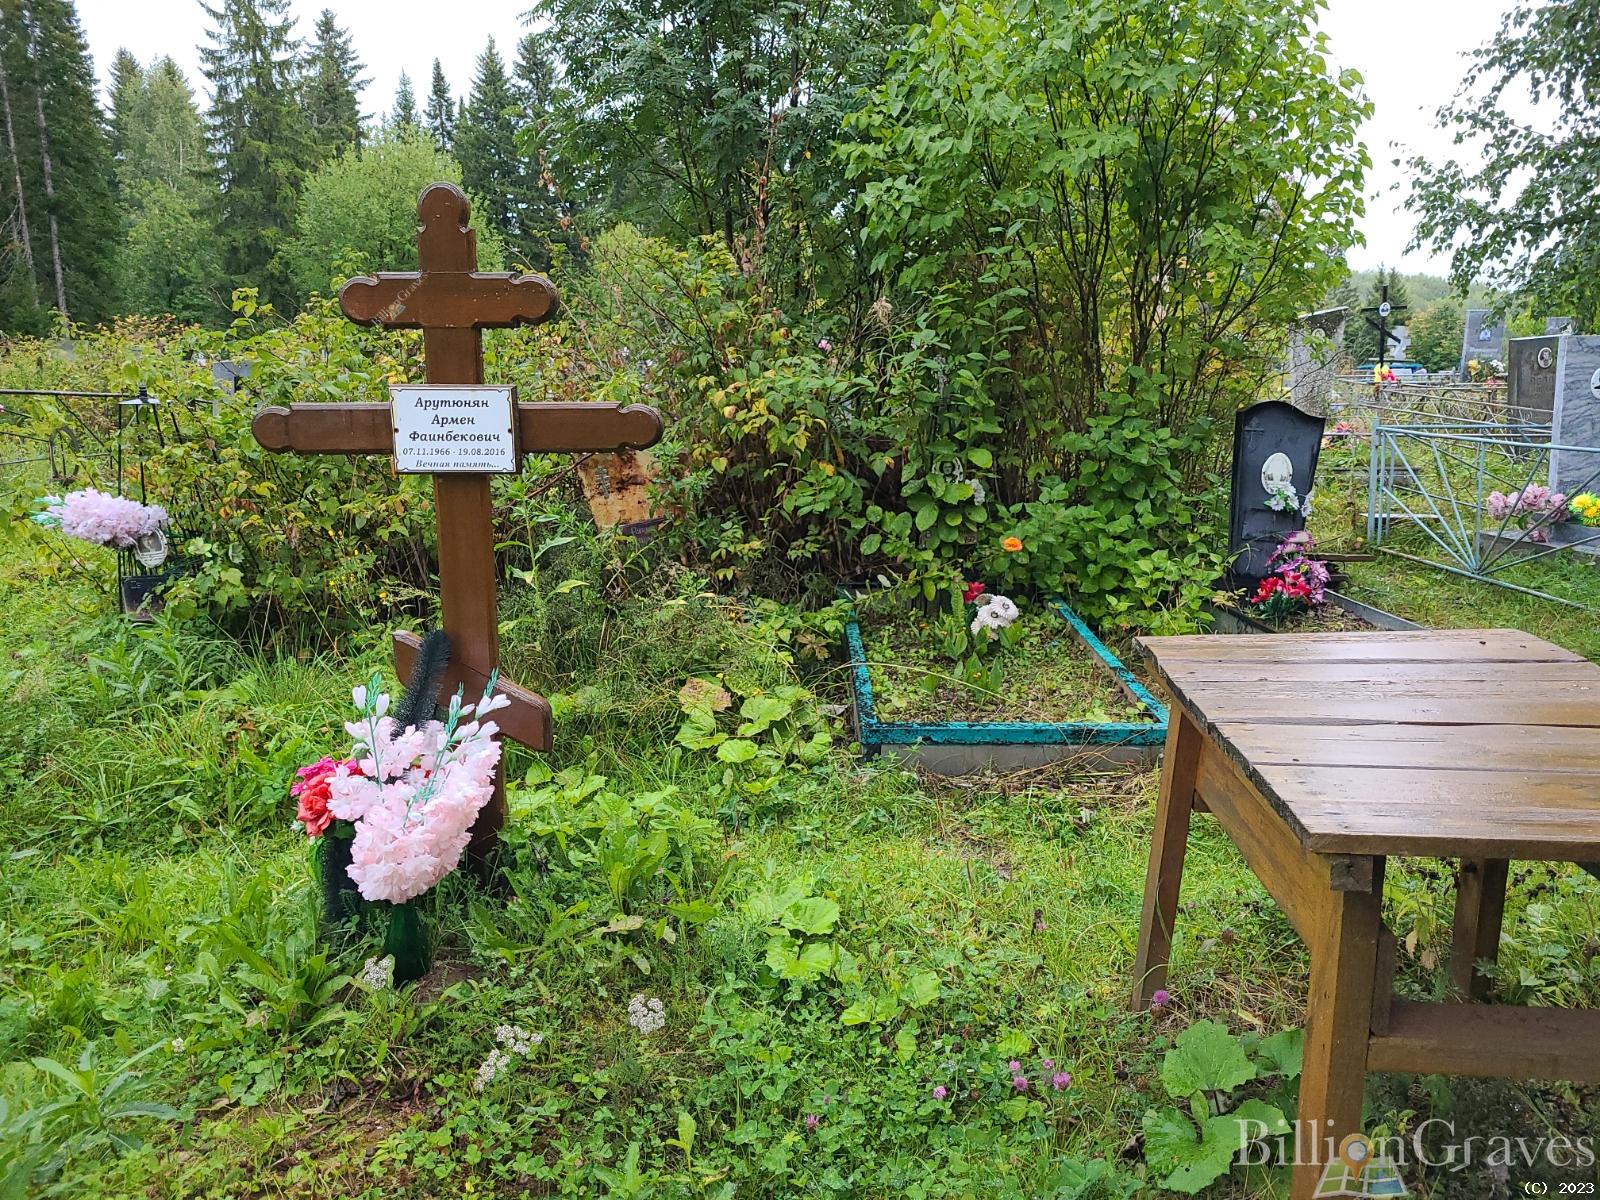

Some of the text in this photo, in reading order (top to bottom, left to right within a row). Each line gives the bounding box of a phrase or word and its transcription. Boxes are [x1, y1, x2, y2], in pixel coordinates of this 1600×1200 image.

[414, 397, 489, 410] Арутюнян
[431, 414, 475, 427] Армен
[409, 431, 500, 441] Фаинбекович
[402, 448, 451, 456] 07.11.1966
[459, 448, 506, 456] 19.08.2016
[415, 460, 451, 468] Вечная
